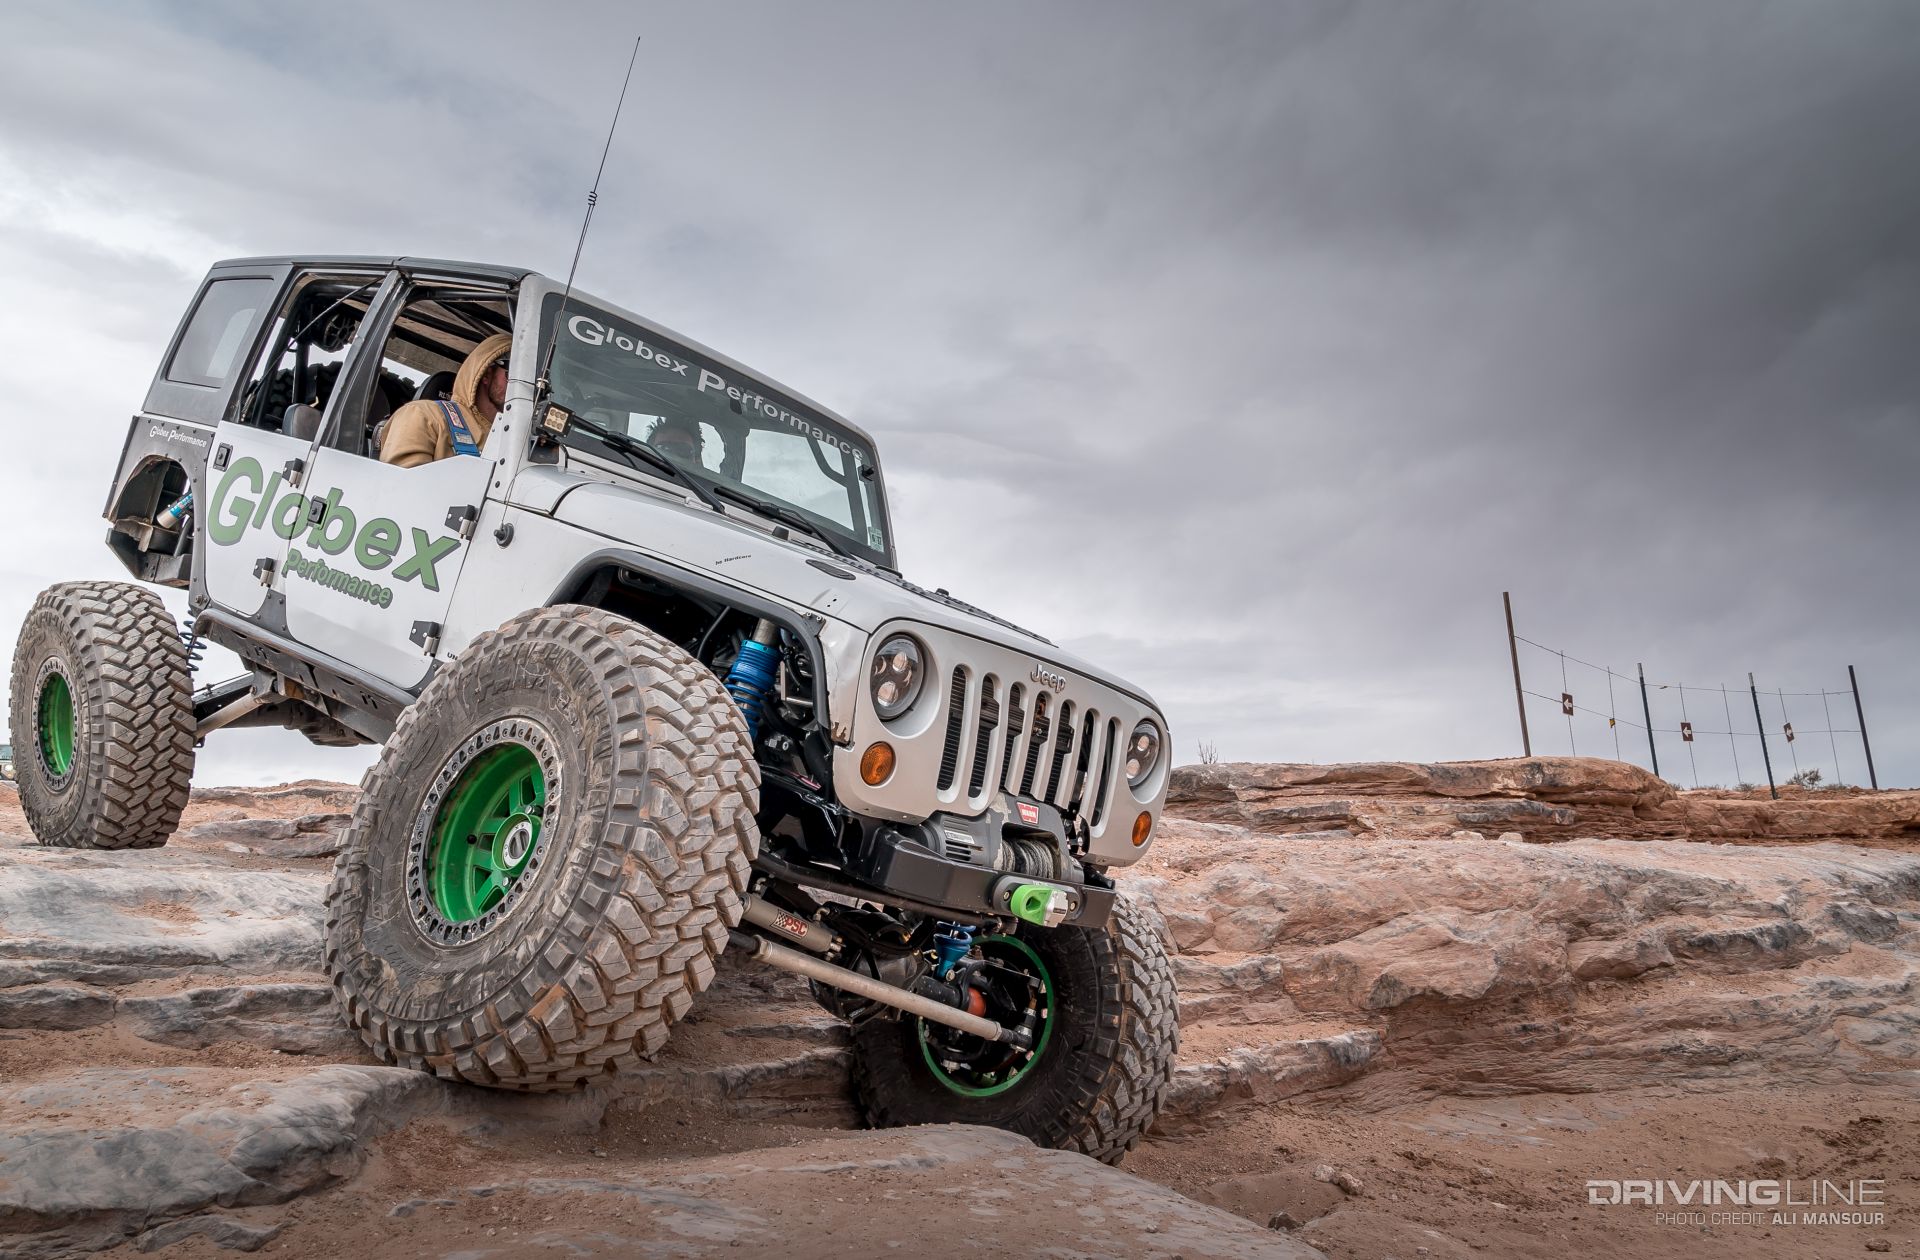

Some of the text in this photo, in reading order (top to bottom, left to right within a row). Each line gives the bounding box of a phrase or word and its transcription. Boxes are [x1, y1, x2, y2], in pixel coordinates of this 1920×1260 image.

[568, 315, 863, 461] Globex Performance
[167, 430, 207, 447] Performance
[208, 457, 461, 592] Globex
[281, 548, 393, 609] Performance
[1030, 664, 1066, 693] Jeep
[784, 916, 807, 936] PSC
